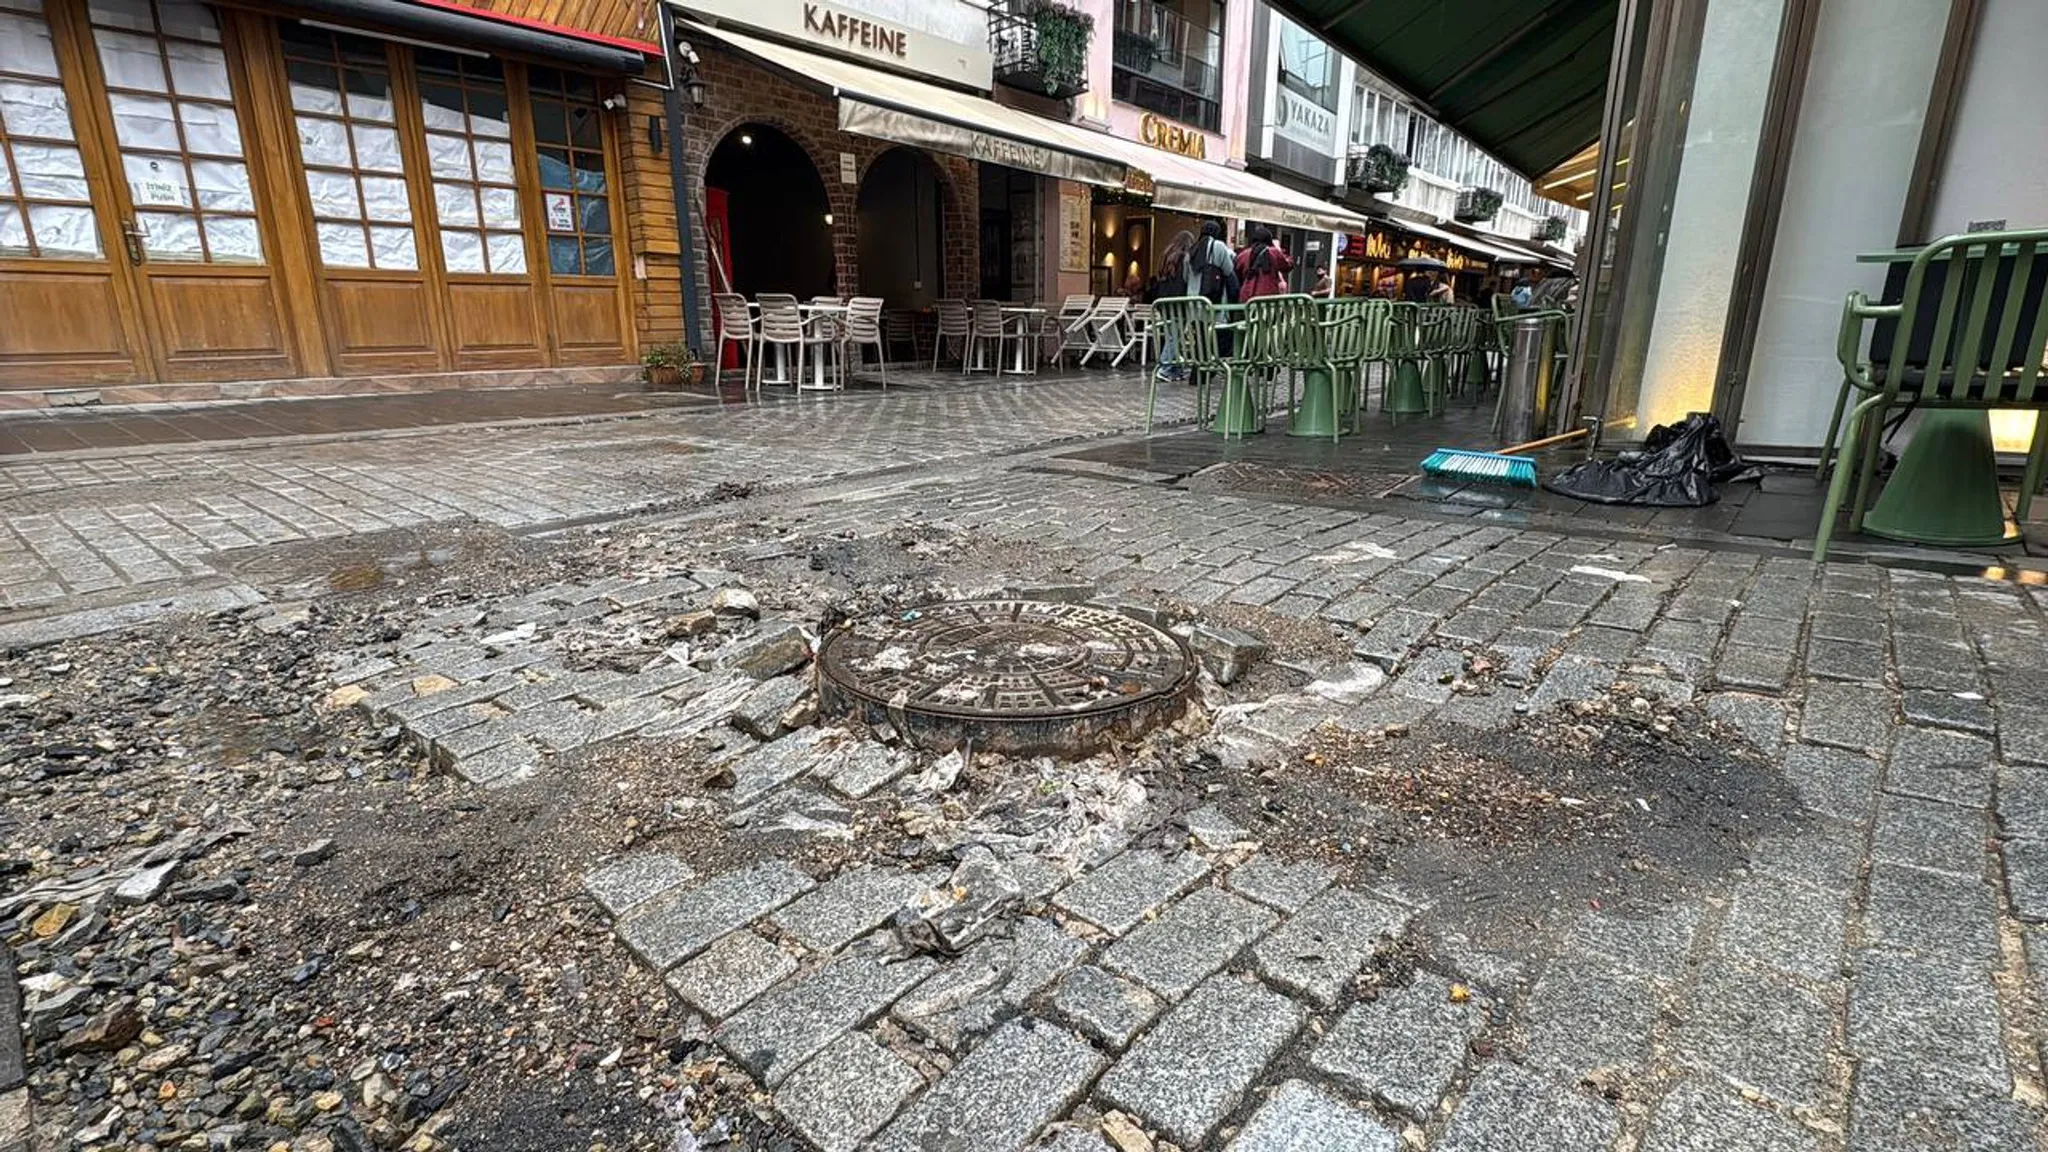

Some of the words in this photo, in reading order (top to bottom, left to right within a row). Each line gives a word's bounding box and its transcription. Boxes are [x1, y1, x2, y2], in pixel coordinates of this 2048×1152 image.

[803, 3, 907, 57] KAFFEINE
[1140, 112, 1206, 159] CREMIA
[1290, 100, 1330, 136] YAKAZA
[971, 132, 1042, 170] KAFFEINE
